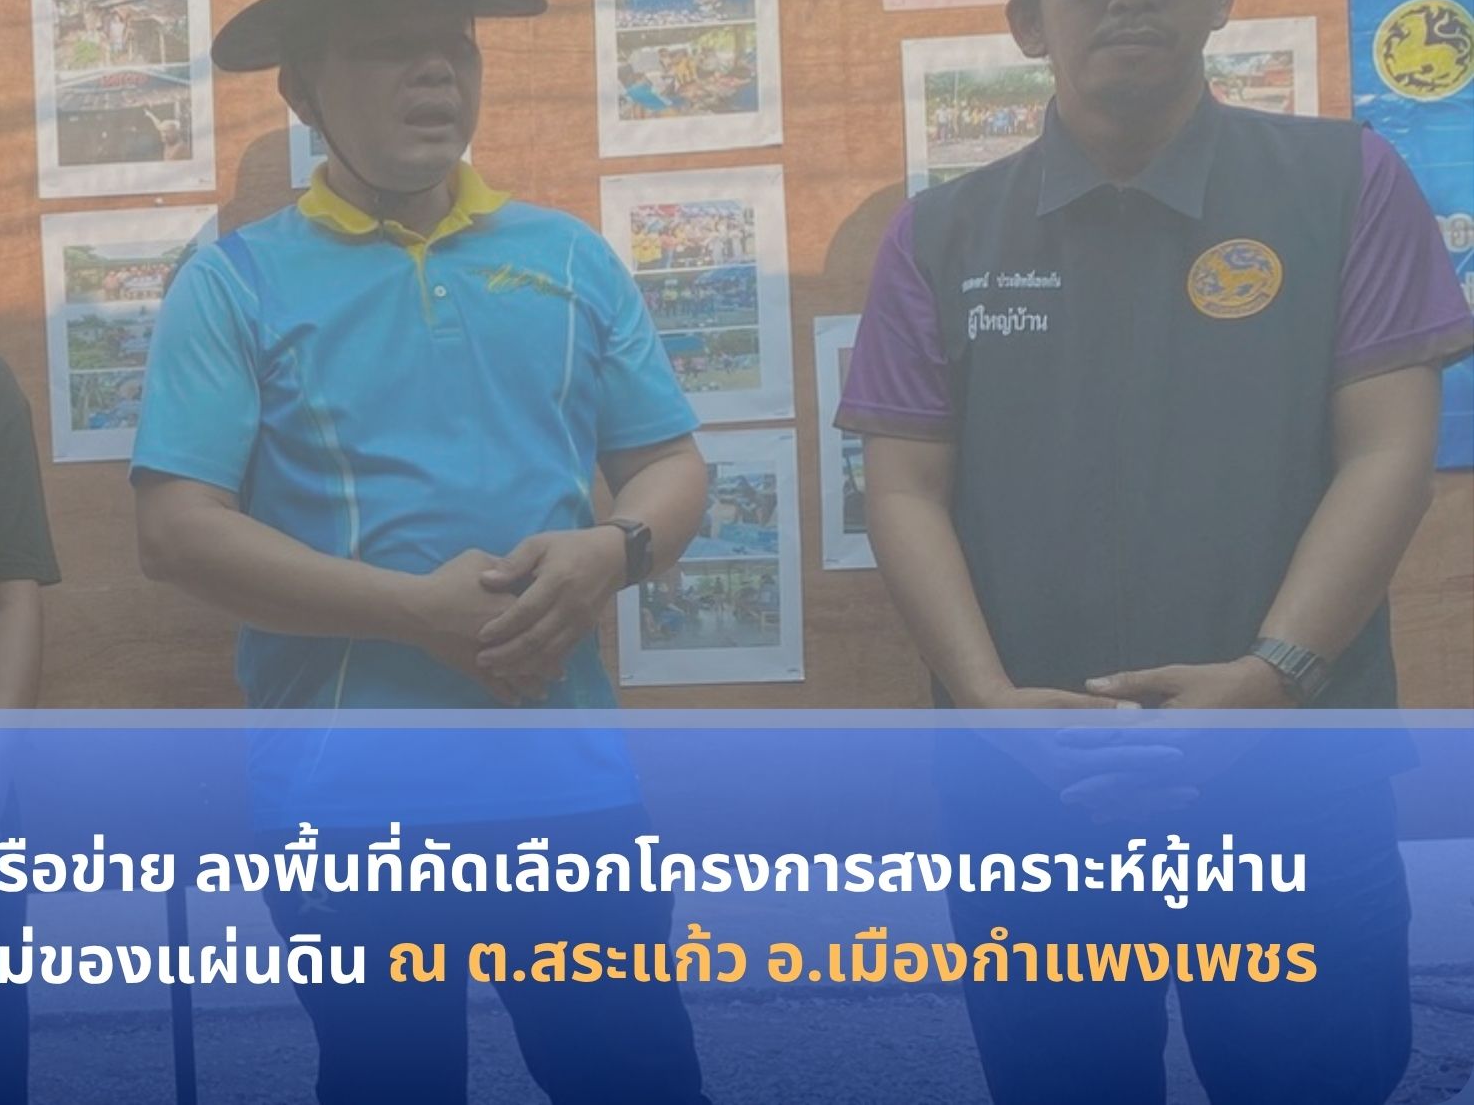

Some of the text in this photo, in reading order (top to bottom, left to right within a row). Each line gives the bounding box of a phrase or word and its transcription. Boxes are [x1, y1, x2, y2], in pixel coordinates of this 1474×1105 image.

[967, 303, 1049, 341] ผู้ใหญ่บ้าน
